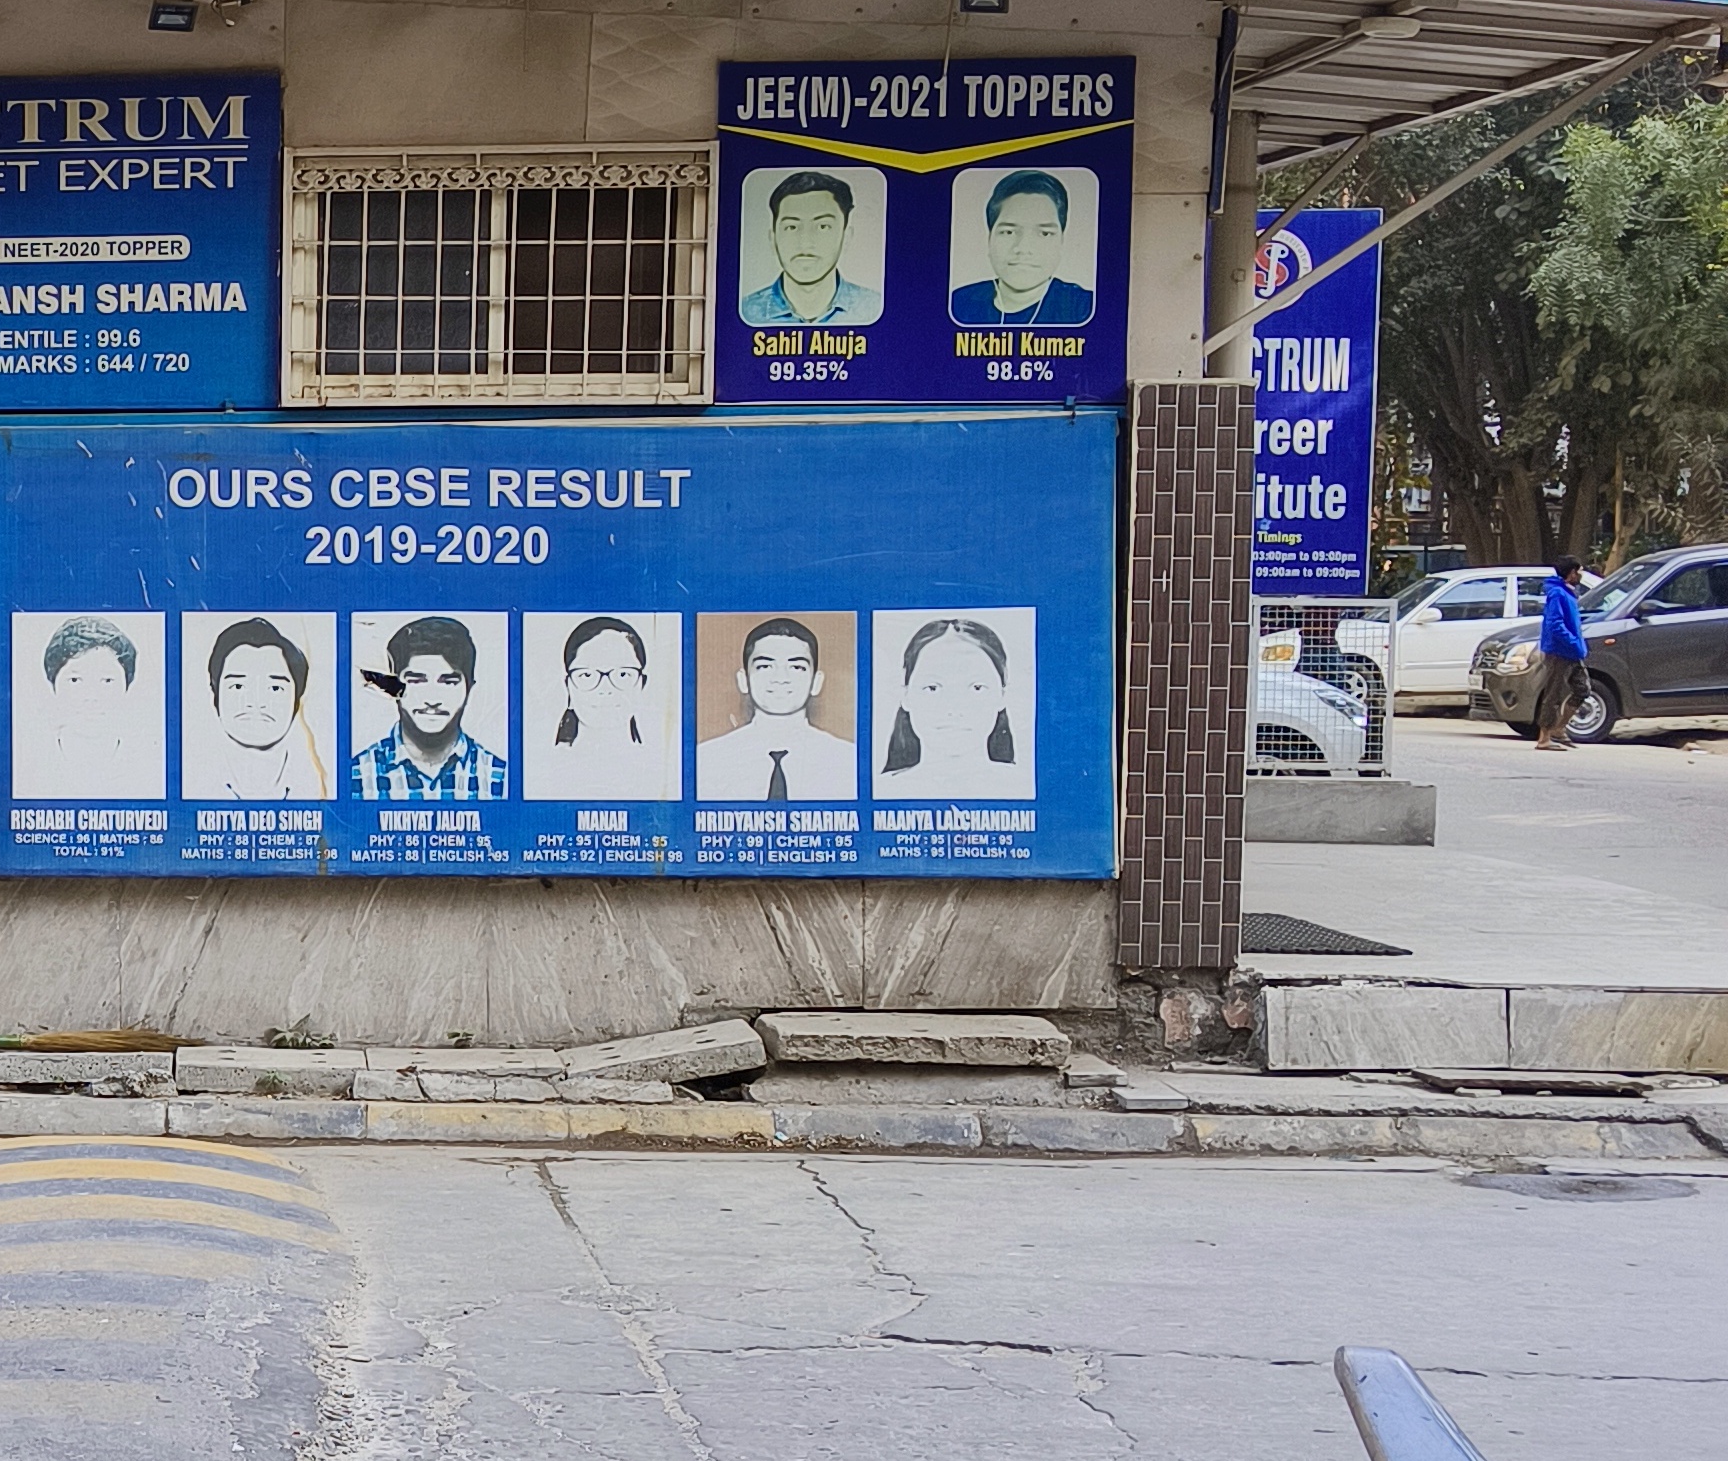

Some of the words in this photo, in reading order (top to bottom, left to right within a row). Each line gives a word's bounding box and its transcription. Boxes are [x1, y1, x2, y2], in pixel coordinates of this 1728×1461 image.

[736, 75, 947, 128] JEE(M)-2021
[964, 73, 1114, 117] TOPPERS
[58, 156, 248, 191] EXPERT
[4, 242, 101, 258] NEET-2020
[106, 241, 183, 257] TOPPER
[96, 282, 247, 313] SHARMA
[97, 329, 141, 348] 99.6
[753, 331, 803, 356] Sahil
[810, 331, 867, 359] Ahuja
[956, 332, 1013, 357] Nikhil
[1021, 333, 1085, 357] Kumar
[97, 354, 135, 373] 644
[153, 353, 190, 372] 720
[770, 361, 848, 381] 99.35%
[987, 361, 1054, 380] 98.6%
[170, 468, 314, 510] OURS
[330, 468, 470, 510] CBSE
[489, 468, 691, 509] RESULT
[304, 525, 550, 566] 2019-2020
[10, 810, 74, 830] RISHABH
[78, 810, 168, 830] CHATURVEDI
[380, 810, 434, 831] VIKHYAT
[436, 811, 481, 831] JALOTA
[695, 811, 786, 832] HRIDYANSH
[790, 811, 859, 832] SHARMA
